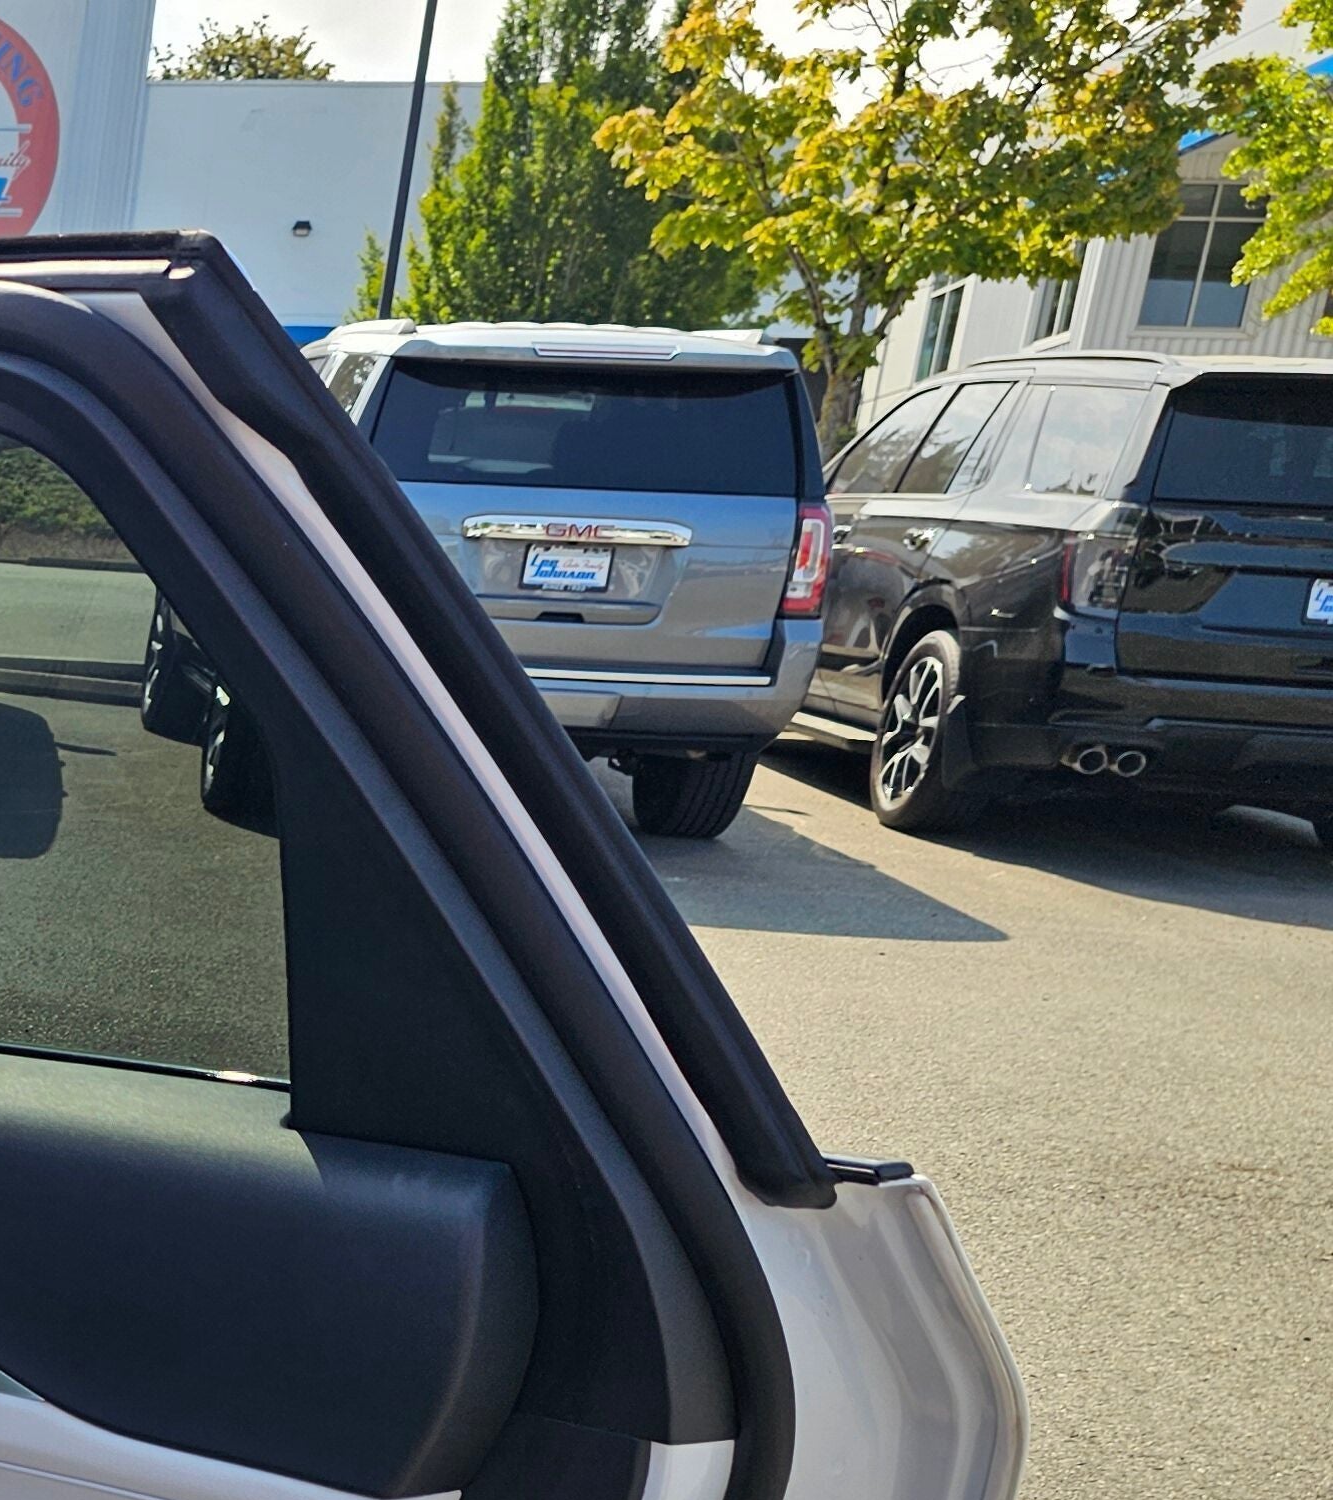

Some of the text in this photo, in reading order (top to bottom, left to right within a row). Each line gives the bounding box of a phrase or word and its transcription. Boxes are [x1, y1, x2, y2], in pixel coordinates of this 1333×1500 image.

[545, 523, 617, 540] GMC
[531, 553, 559, 567] Lee
[532, 566, 596, 580] Johnson
